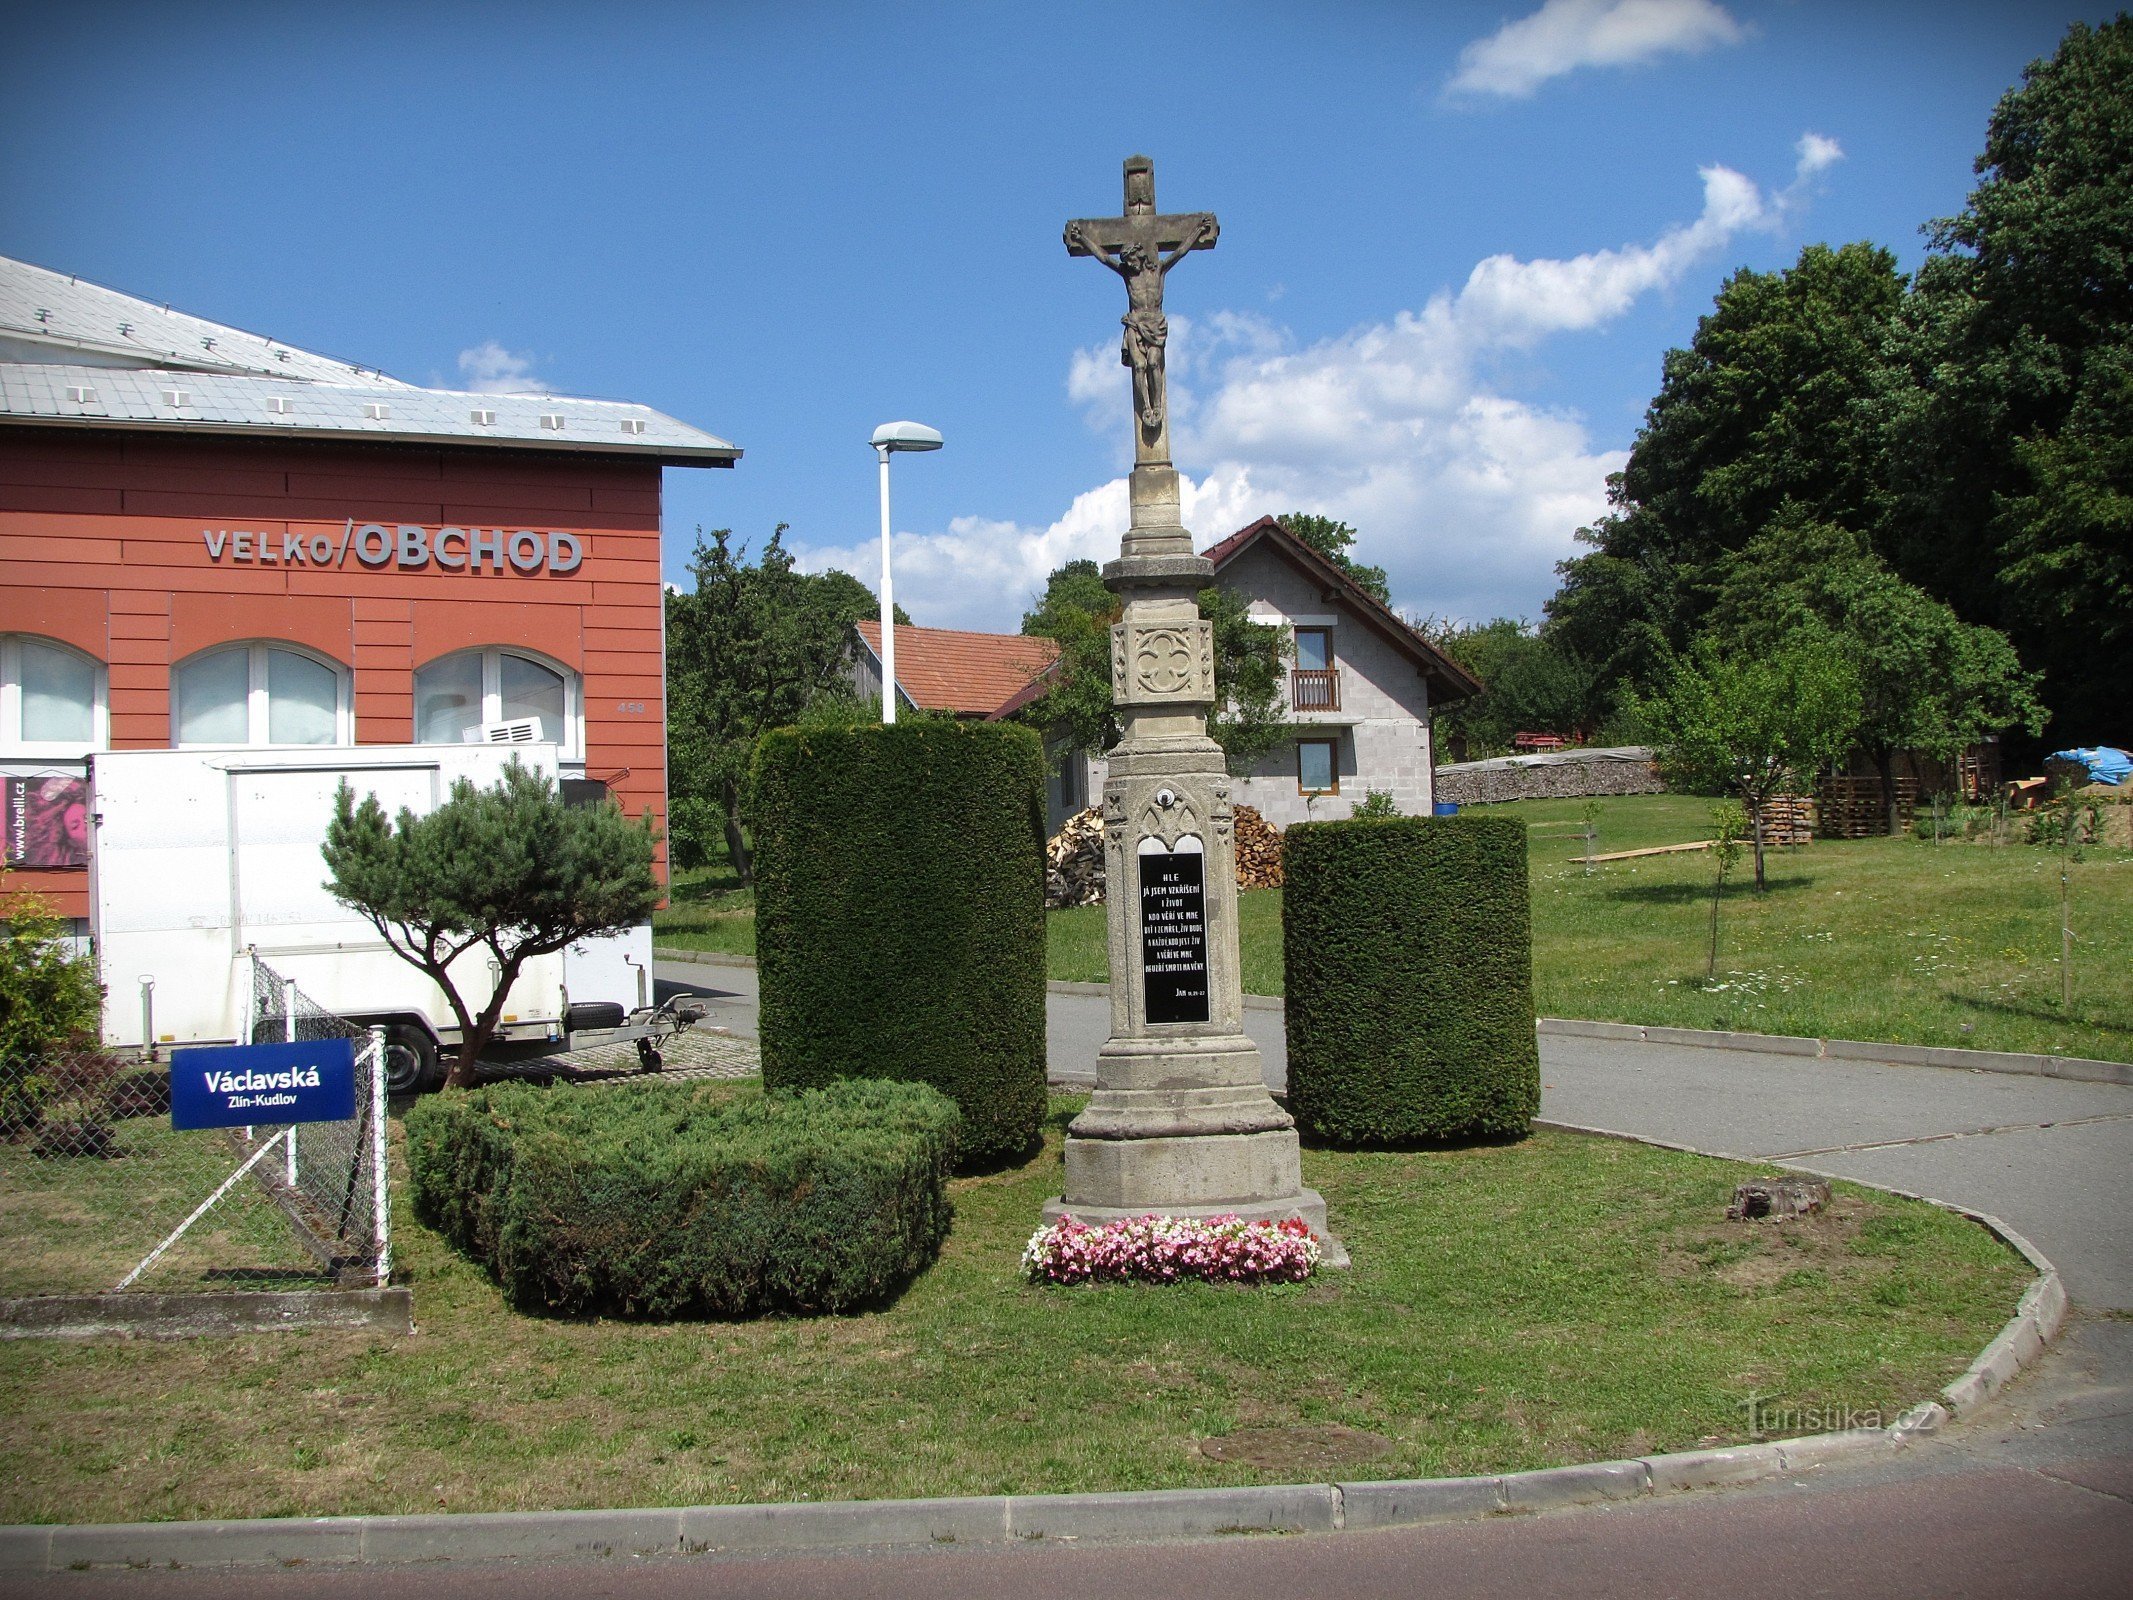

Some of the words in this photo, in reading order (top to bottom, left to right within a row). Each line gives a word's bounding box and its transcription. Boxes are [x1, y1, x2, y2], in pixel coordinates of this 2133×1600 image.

[13, 782, 25, 860] www.brelil.cz
[1163, 873, 1179, 882] HLE
[1143, 885, 1150, 897] JÁ
[1151, 886, 1167, 897] JSEM
[1168, 883, 1200, 894] VZKŘÍŠENÍ
[1166, 897, 1183, 907] ŽIVOT
[1148, 913, 1160, 921] KDO
[1161, 910, 1175, 921] VĚŘÍ
[1177, 911, 1184, 920] VE
[1191, 935, 1201, 945] ŽIV
[1165, 963, 1182, 972] SMRTI
[204, 1066, 321, 1093] Václavská
[228, 1094, 297, 1109] Zlín-Kudlov
